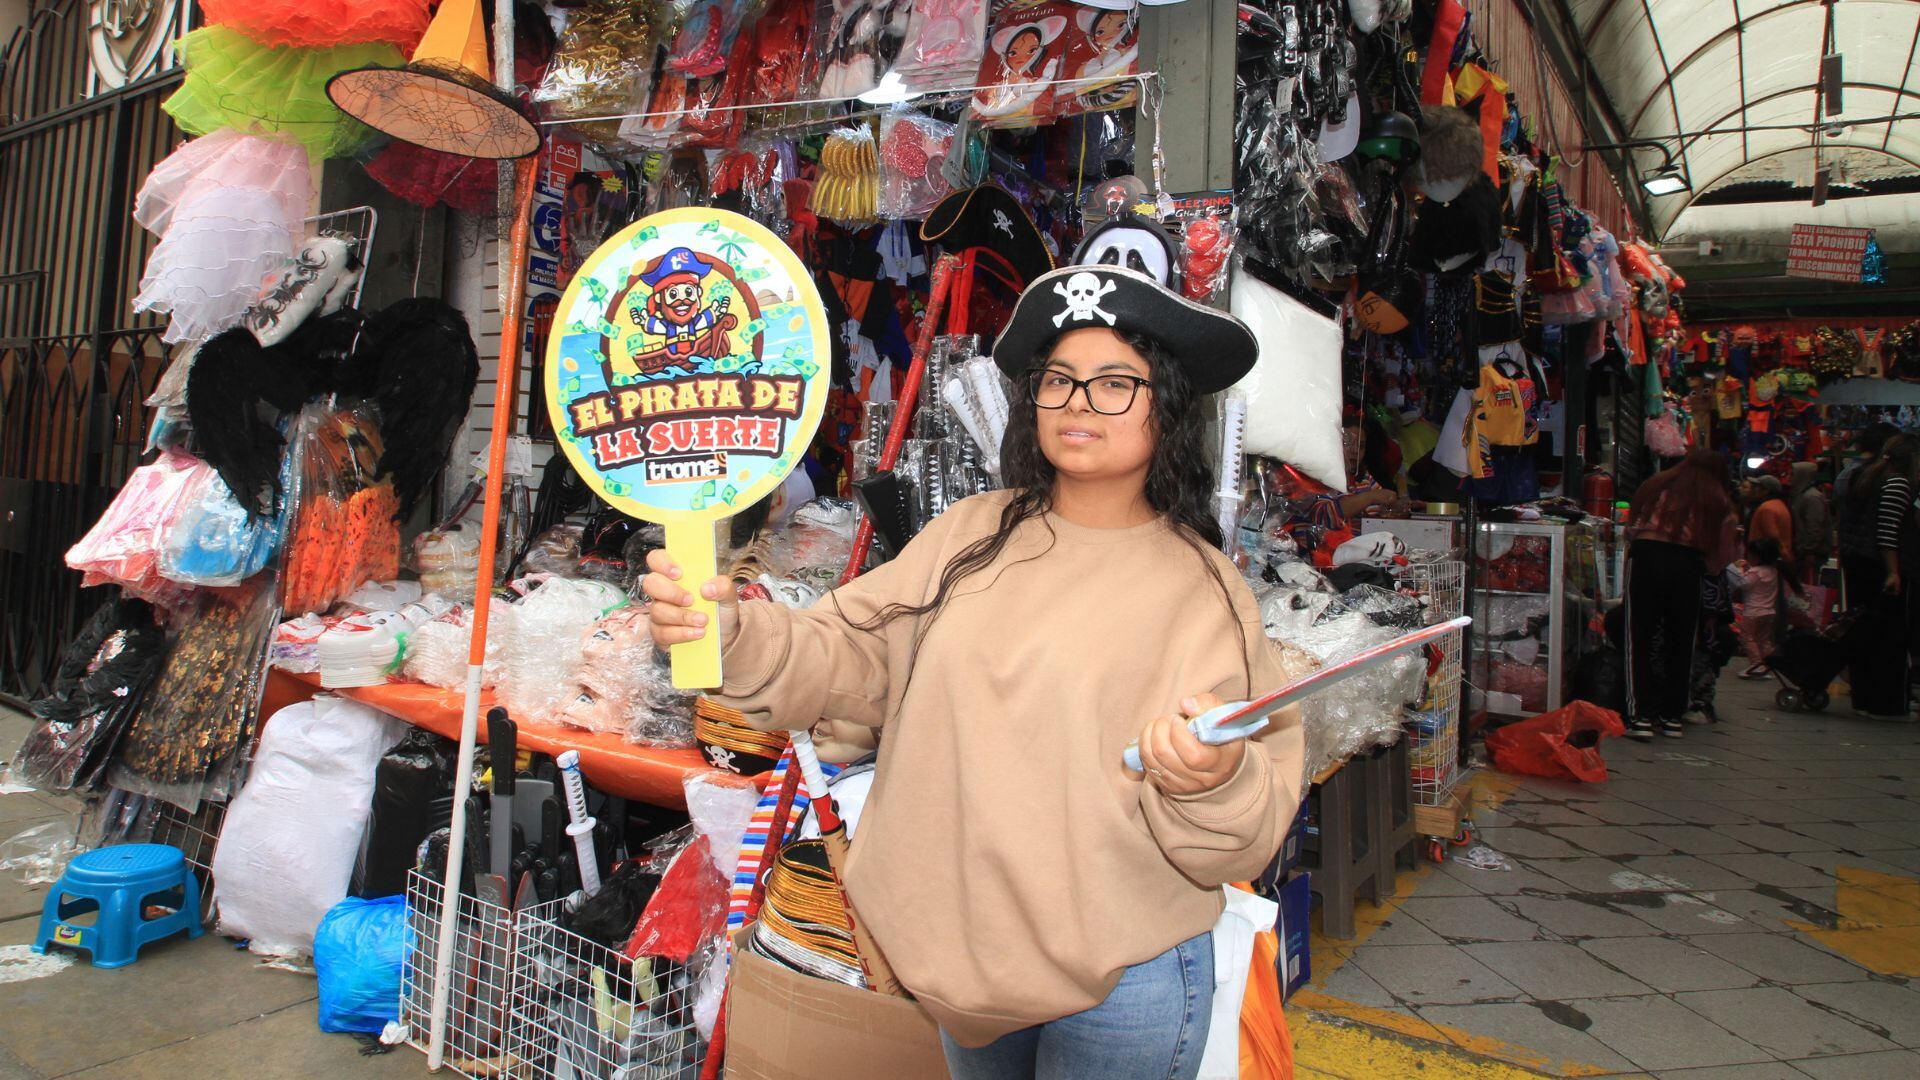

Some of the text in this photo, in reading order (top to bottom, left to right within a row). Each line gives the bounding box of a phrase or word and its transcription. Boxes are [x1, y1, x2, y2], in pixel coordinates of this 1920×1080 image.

[1791, 233, 1866, 249] ESTÁ PROHIBID
[1851, 252, 1862, 261] AC
[1798, 260, 1861, 273] DISCRIMINACIÓ
[531, 274, 557, 285] DE MASCA
[573, 379, 801, 433] EL PIRATA DE
[596, 415, 781, 466] LA SUERTE
[648, 459, 720, 480] trome
